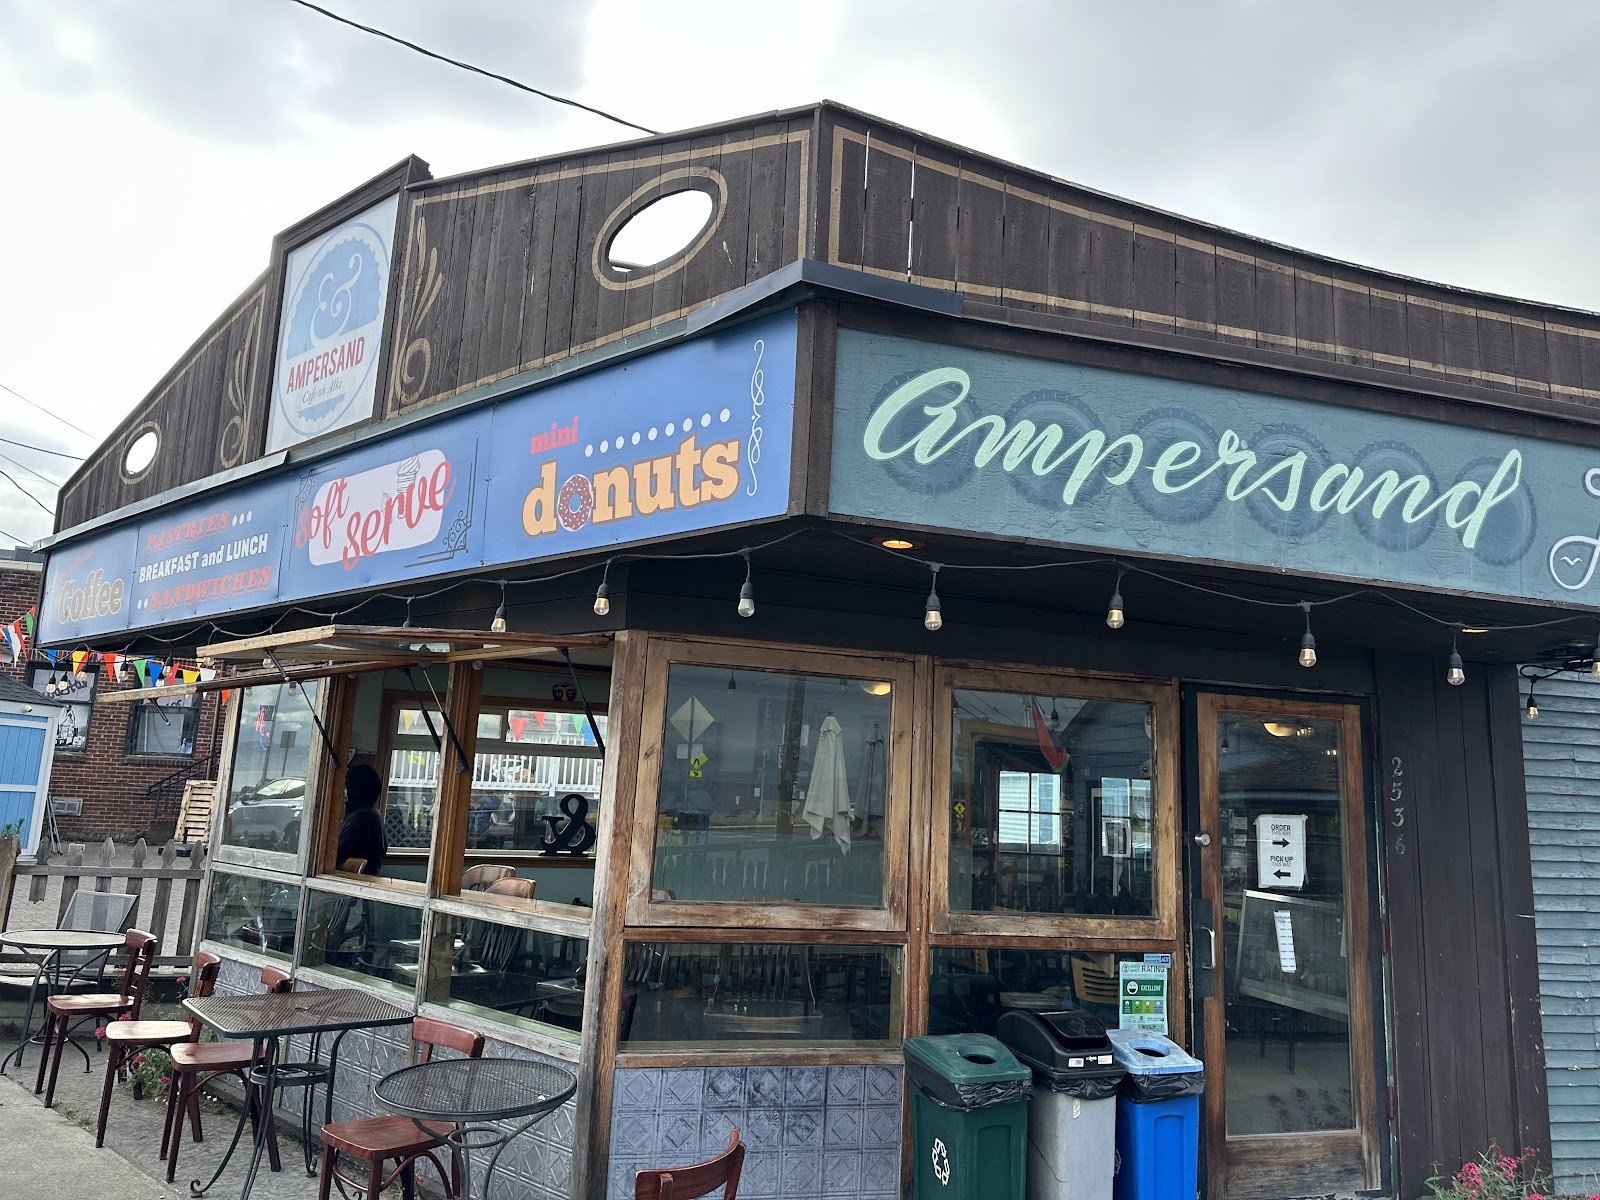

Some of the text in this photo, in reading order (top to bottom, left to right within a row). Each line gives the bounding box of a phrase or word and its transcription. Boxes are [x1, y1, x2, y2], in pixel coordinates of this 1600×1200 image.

[286, 336, 365, 395] AMPERSAND
[530, 416, 580, 455] mini
[295, 475, 350, 550] soft
[521, 432, 743, 539] donuts
[146, 509, 231, 555] PASTRIES
[342, 460, 458, 572] serve
[138, 532, 269, 584] BREAKFAST and LUNCH
[57, 568, 125, 624] Coffee
[149, 565, 272, 612] SANDWICHES
[1390, 756, 1406, 855] 2536
[1141, 964, 1165, 973] RATING
